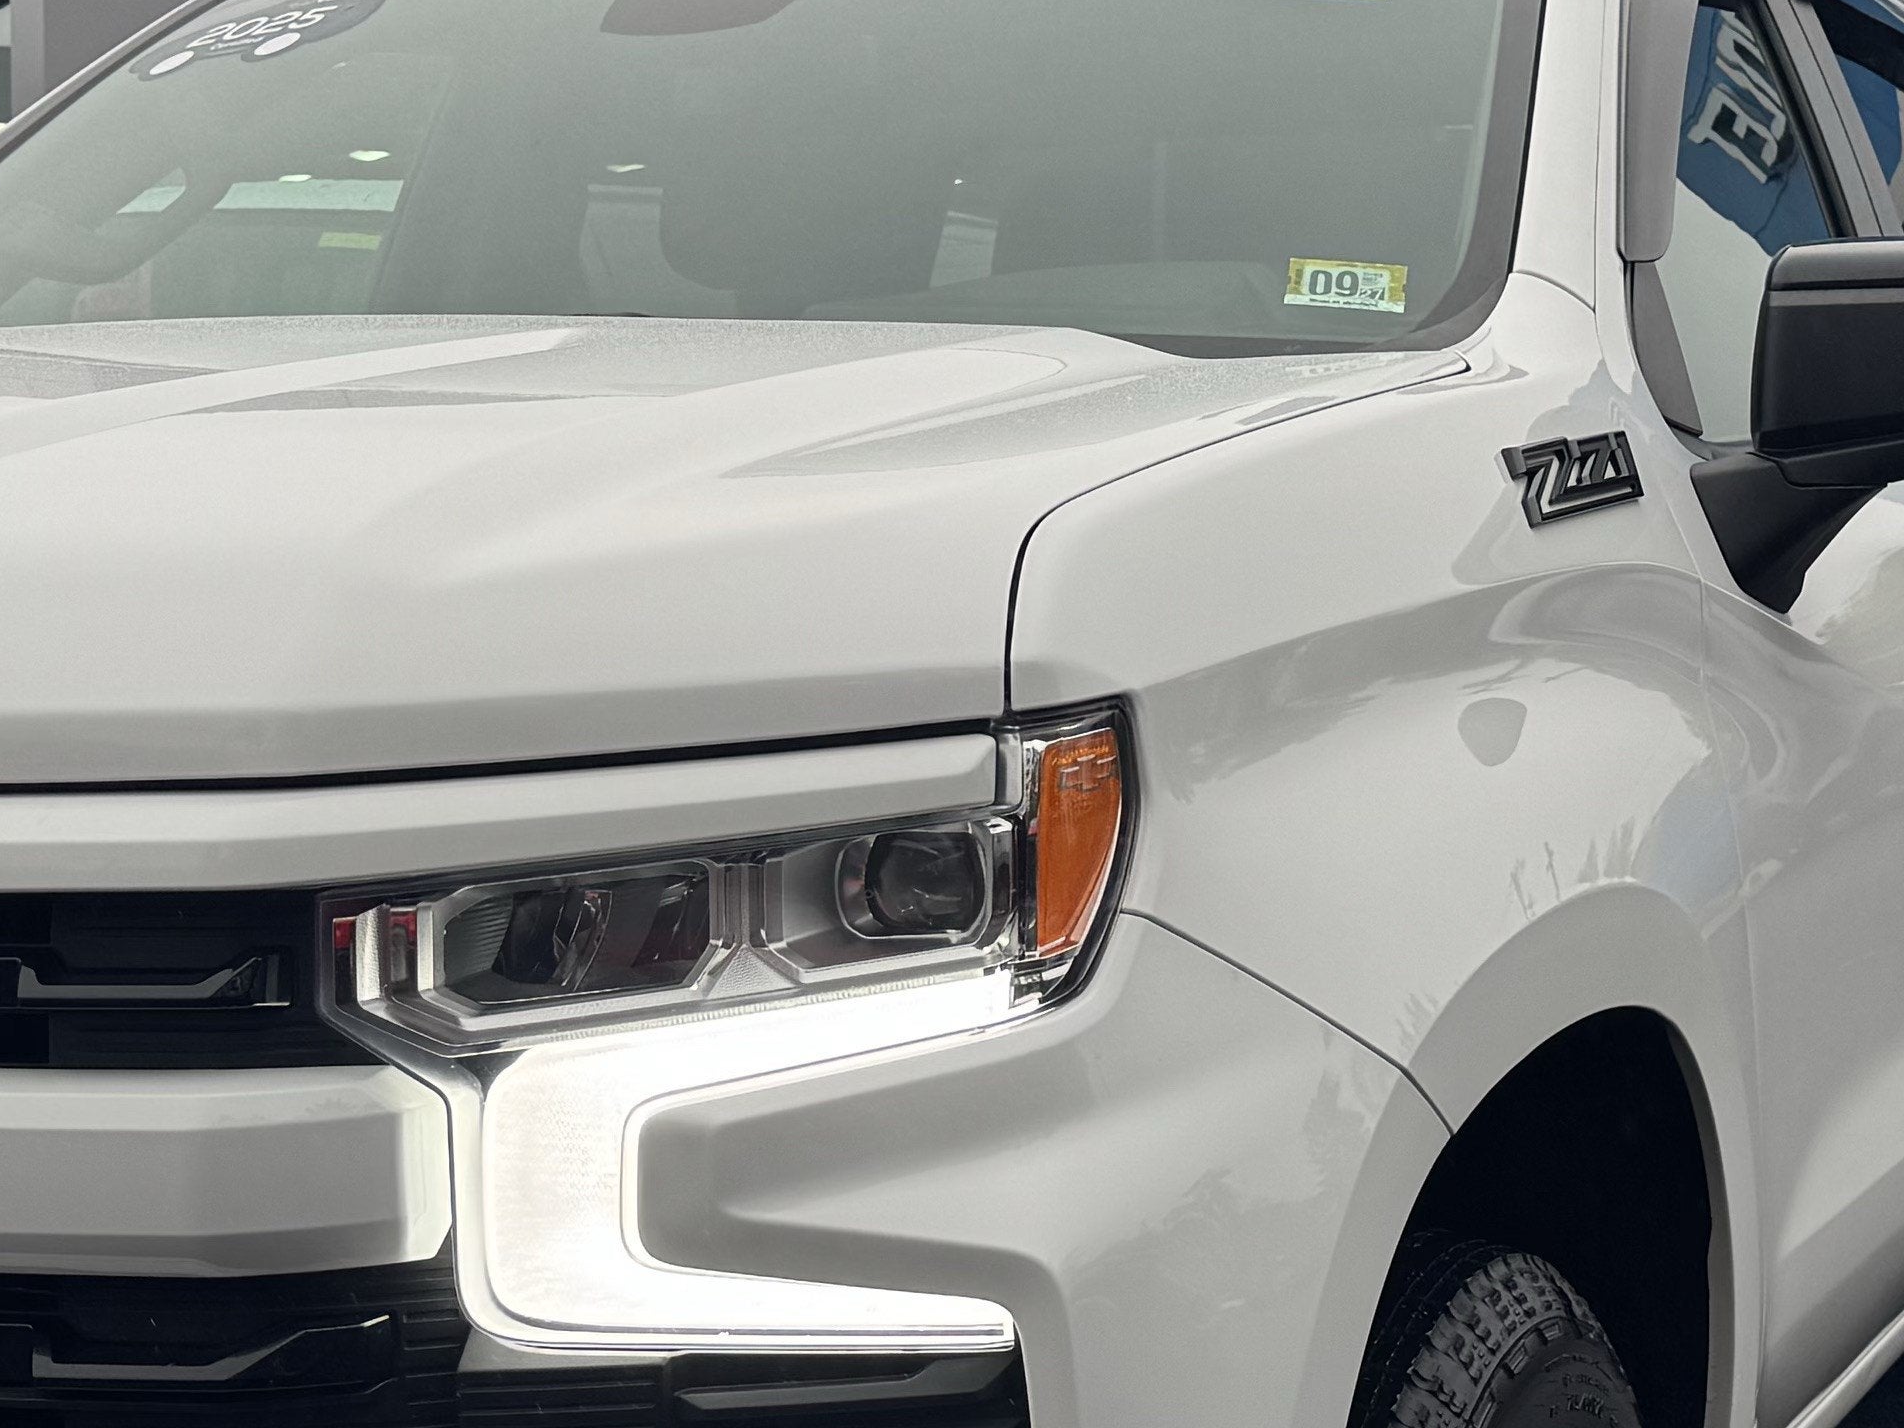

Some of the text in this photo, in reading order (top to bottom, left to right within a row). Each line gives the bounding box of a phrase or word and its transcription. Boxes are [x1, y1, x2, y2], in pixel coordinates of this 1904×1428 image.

[186, 5, 338, 49] 2025
[1308, 269, 1360, 297] 09
[1500, 430, 1645, 529] Z71
